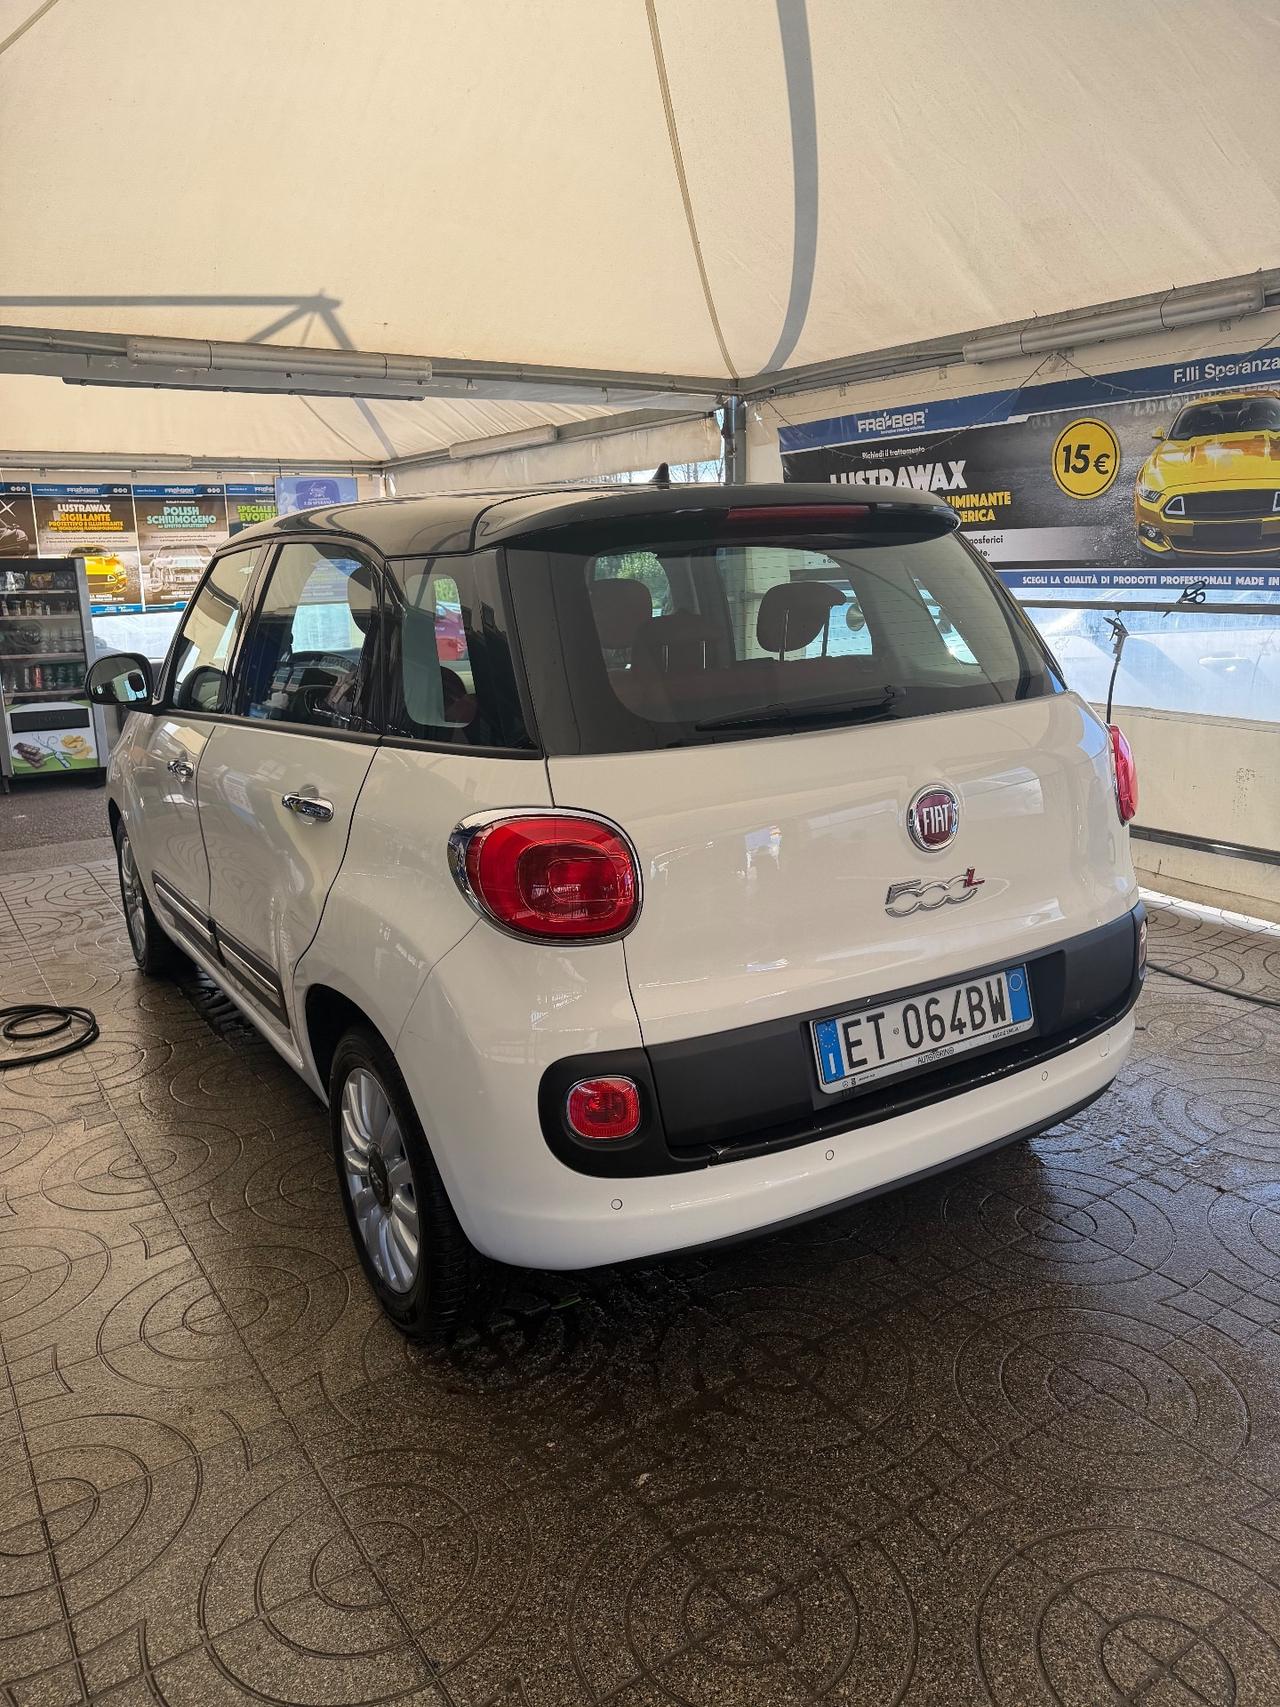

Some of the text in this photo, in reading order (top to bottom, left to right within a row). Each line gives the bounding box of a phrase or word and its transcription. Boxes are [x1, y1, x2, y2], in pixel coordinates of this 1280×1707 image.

[1173, 356, 1280, 383] F.lli Speranza
[57, 503, 112, 513] LUSTRAWAX
[163, 506, 200, 516] POLISH
[60, 513, 111, 521] SIGILLANTE
[146, 515, 217, 525] SCHIUMOGENO
[1022, 573, 1280, 587] SCEGLI LA QUALITÀ DI PRODOTTI PROFESSIONALI MADE IN
[922, 803, 950, 836] FIAT
